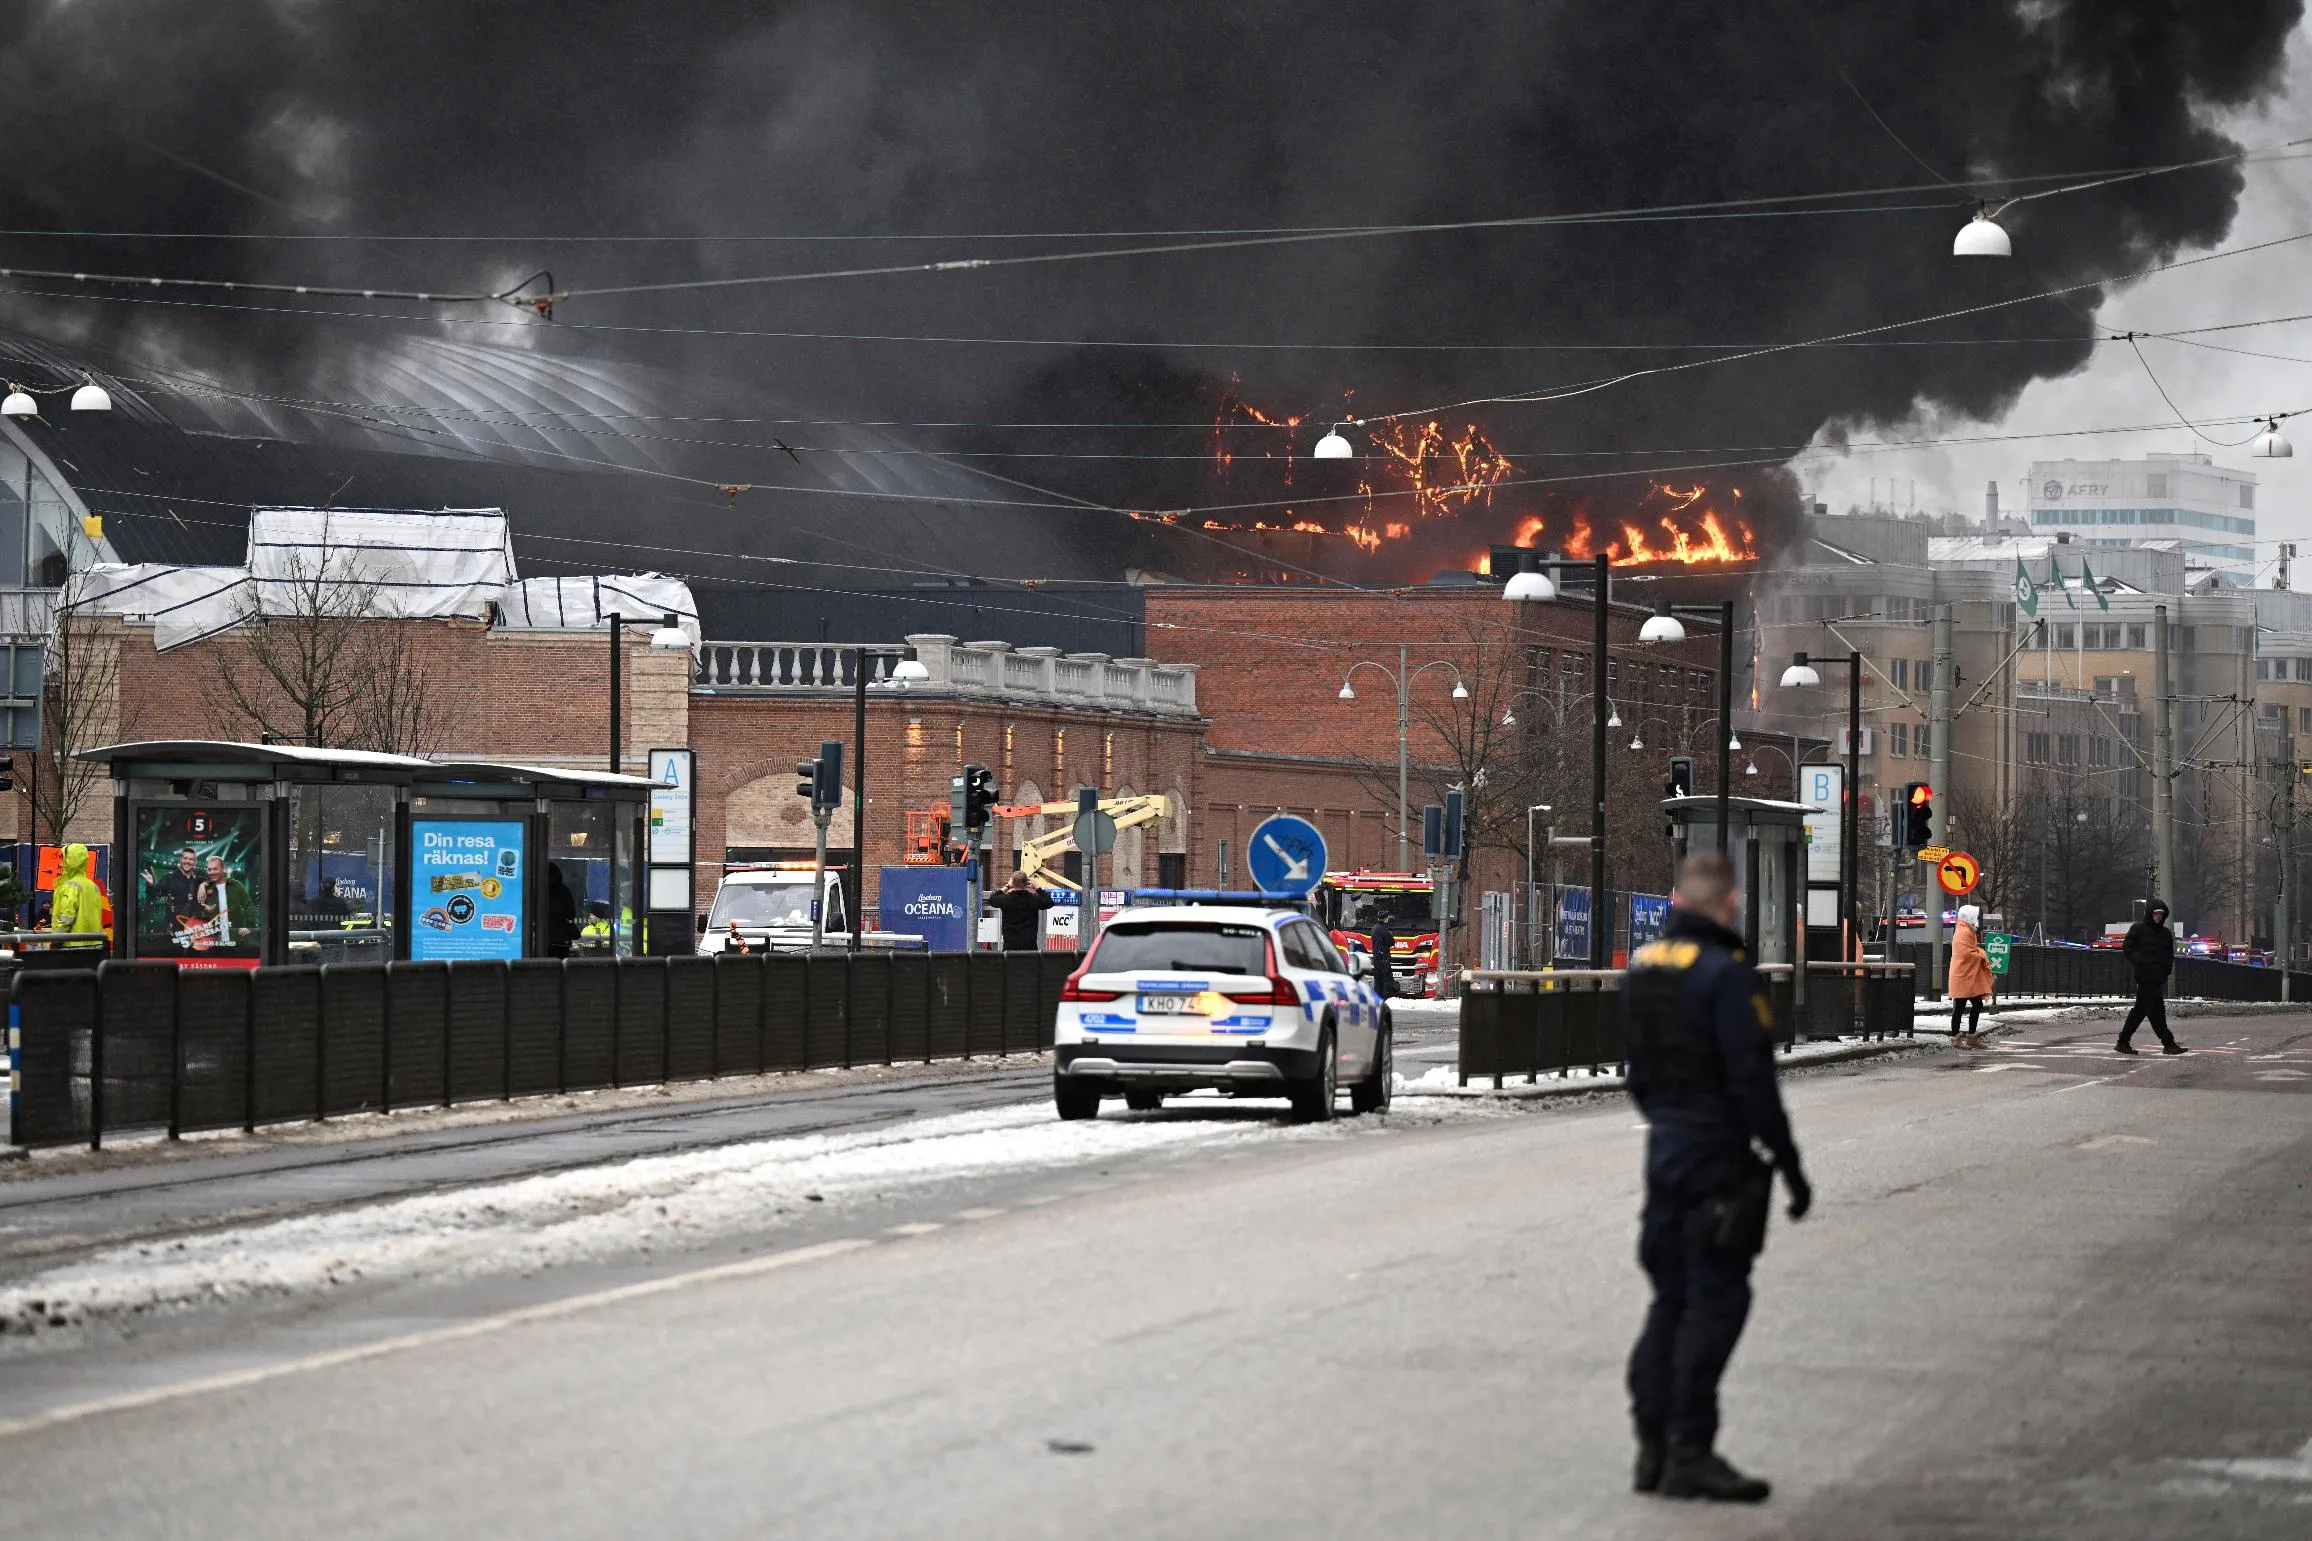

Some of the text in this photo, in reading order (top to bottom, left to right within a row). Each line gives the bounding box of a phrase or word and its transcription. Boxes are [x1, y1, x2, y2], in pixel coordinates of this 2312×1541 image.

[2067, 484, 2108, 496] AFRY
[664, 758, 679, 785] A
[1815, 774, 1828, 801] B
[195, 819, 204, 831] 5
[424, 832, 496, 848] Din resa
[424, 851, 489, 865] räknas!
[904, 903, 954, 915] OCEANA
[1052, 916, 1069, 926] NCC
[1148, 996, 1174, 1010] KHO
